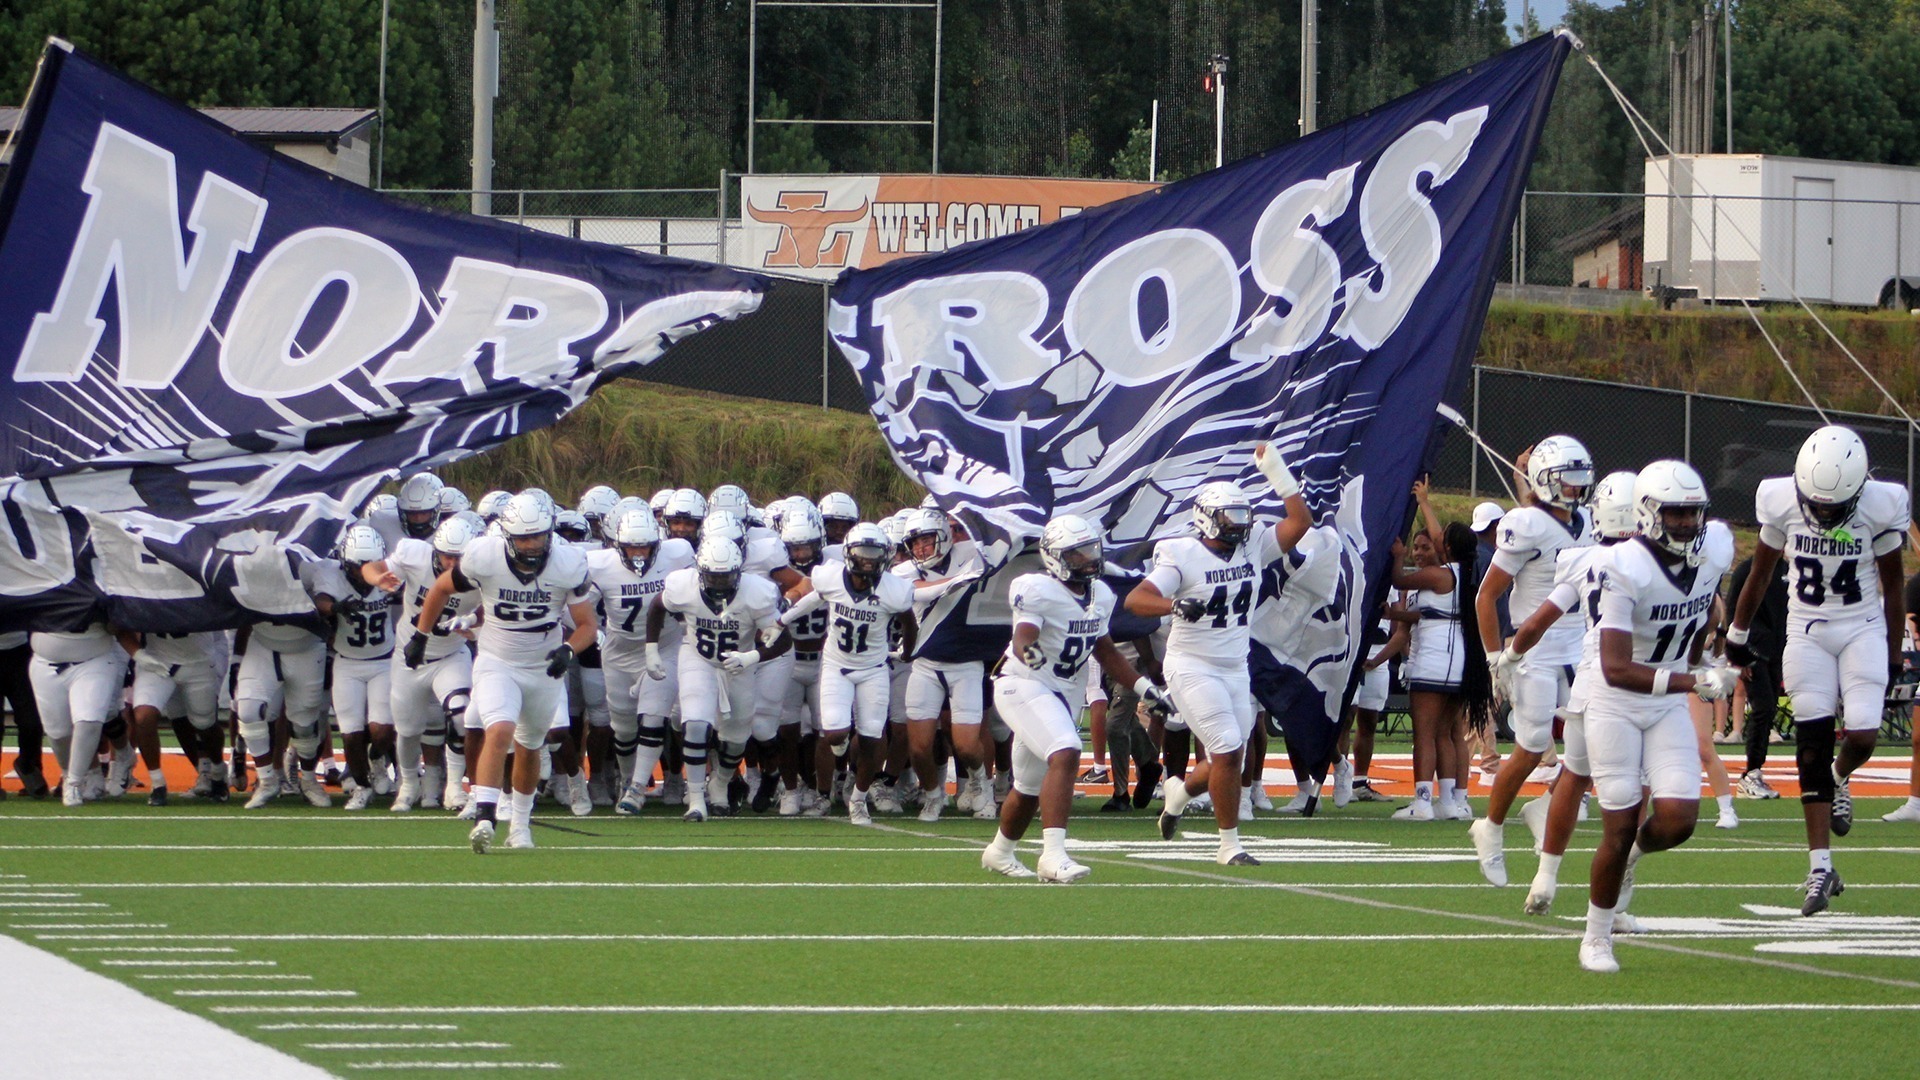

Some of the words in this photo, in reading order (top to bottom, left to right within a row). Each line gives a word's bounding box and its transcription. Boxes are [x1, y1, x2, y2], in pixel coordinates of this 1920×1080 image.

[829, 105, 1489, 388] ROSS
[1795, 533, 1862, 556] NORCROSS
[498, 588, 551, 603] NORCROSS
[621, 579, 665, 596] NORCROSS
[1794, 555, 1862, 607] 84
[621, 597, 643, 632] 7
[834, 602, 878, 623] NORCROSS
[1206, 581, 1253, 628] 44
[1649, 592, 1711, 621] NORCROSS
[347, 611, 387, 647] 39
[696, 616, 740, 630] NORCROSS
[834, 616, 869, 653] 31
[1645, 618, 1697, 663] 11
[696, 628, 739, 662] 66
[1053, 636, 1098, 679] 97
